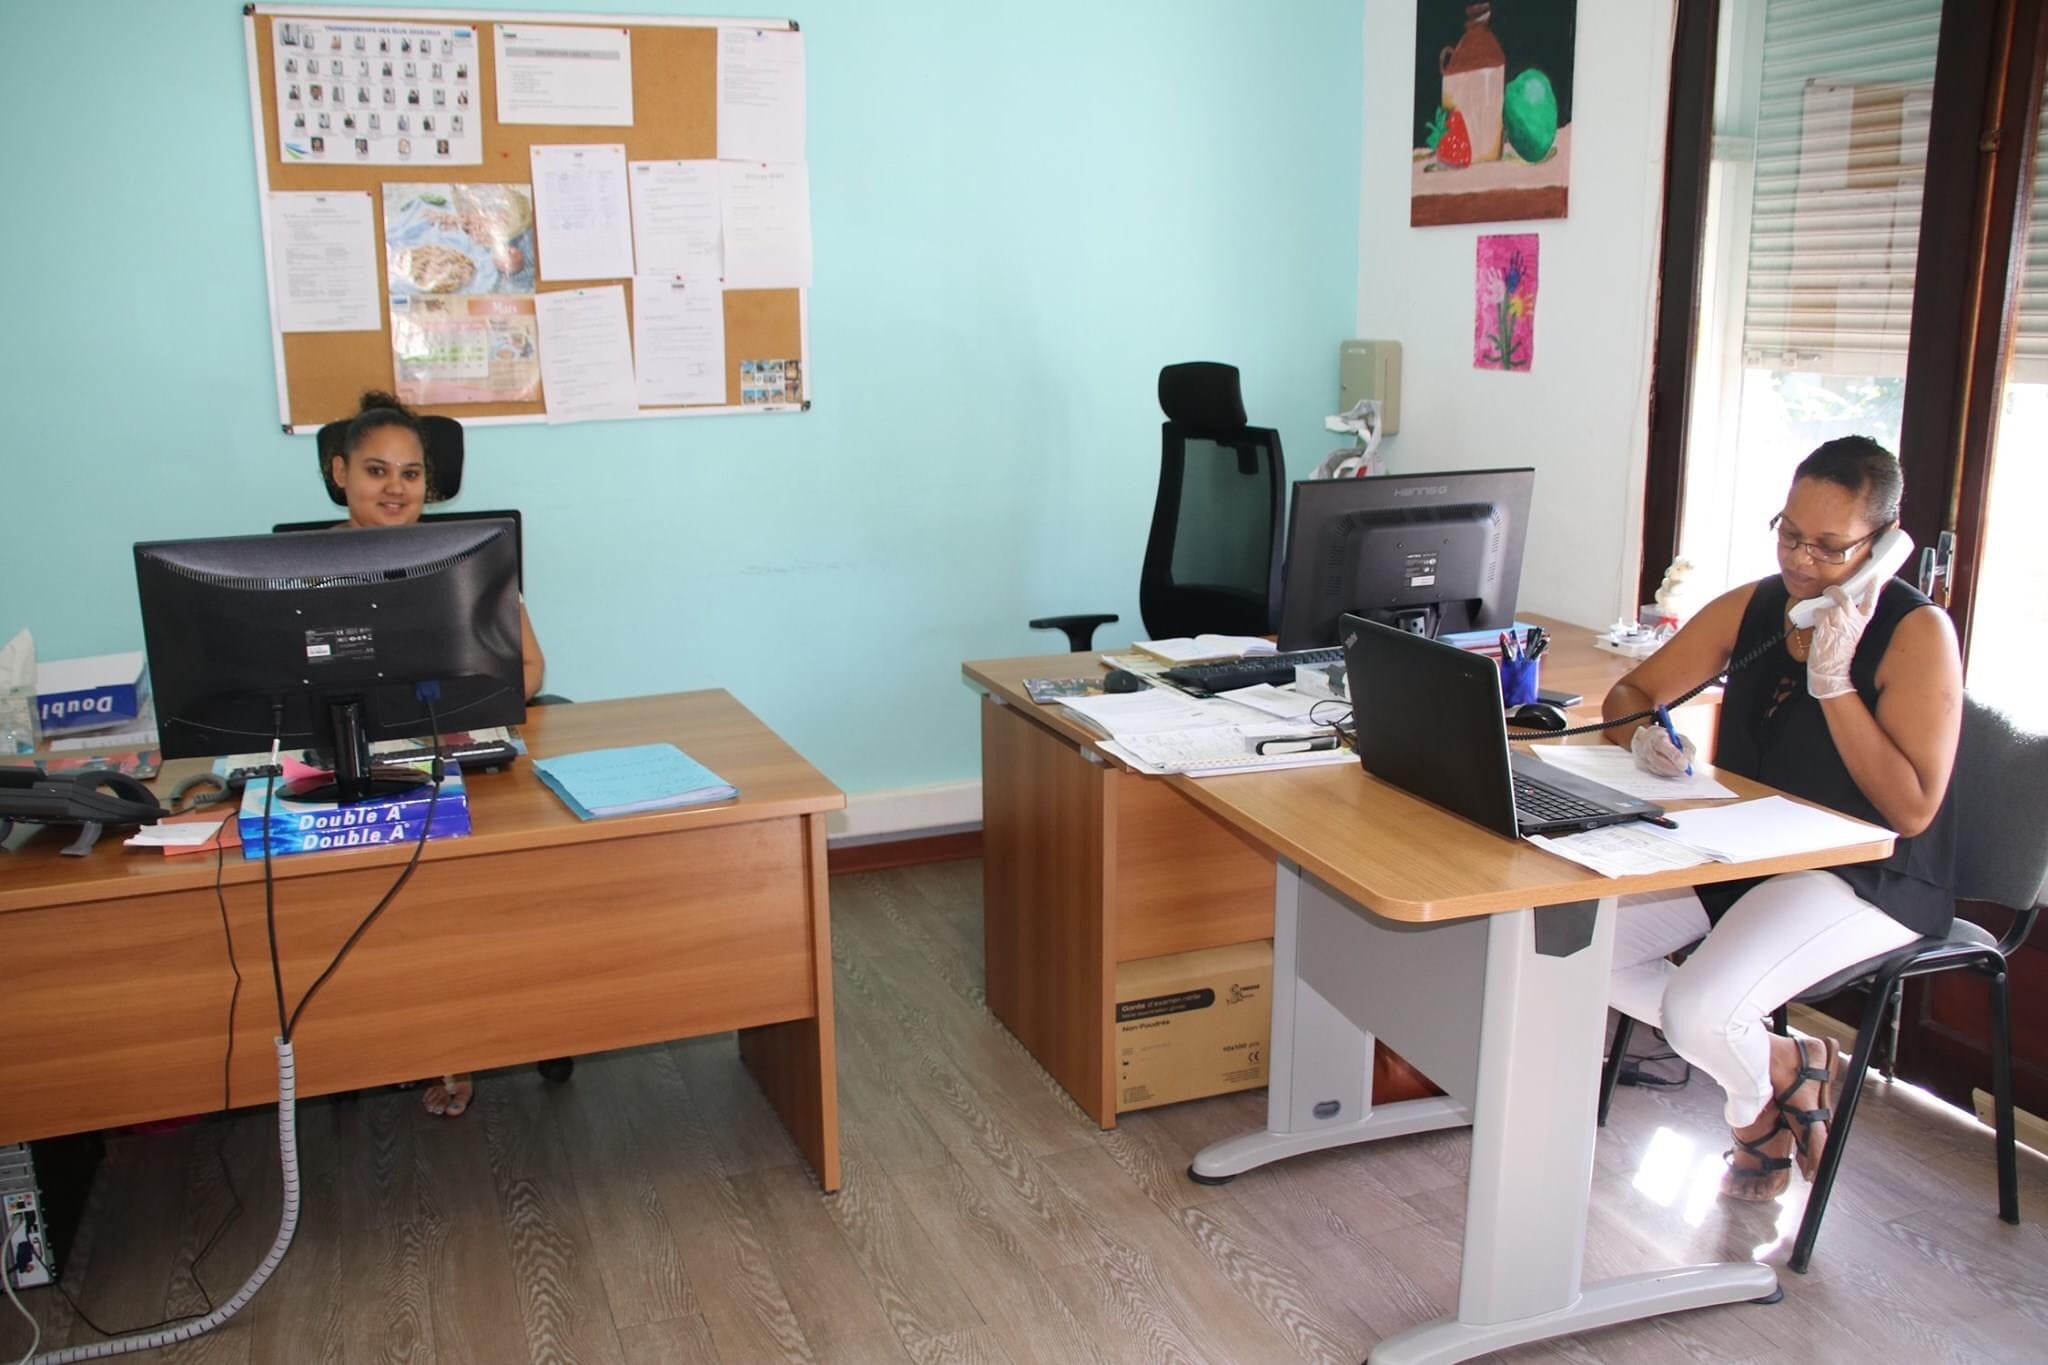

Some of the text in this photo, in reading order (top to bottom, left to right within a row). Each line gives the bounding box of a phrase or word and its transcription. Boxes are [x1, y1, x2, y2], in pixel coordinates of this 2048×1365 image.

[299, 805, 401, 830] Double A
[303, 824, 404, 851] Double A
